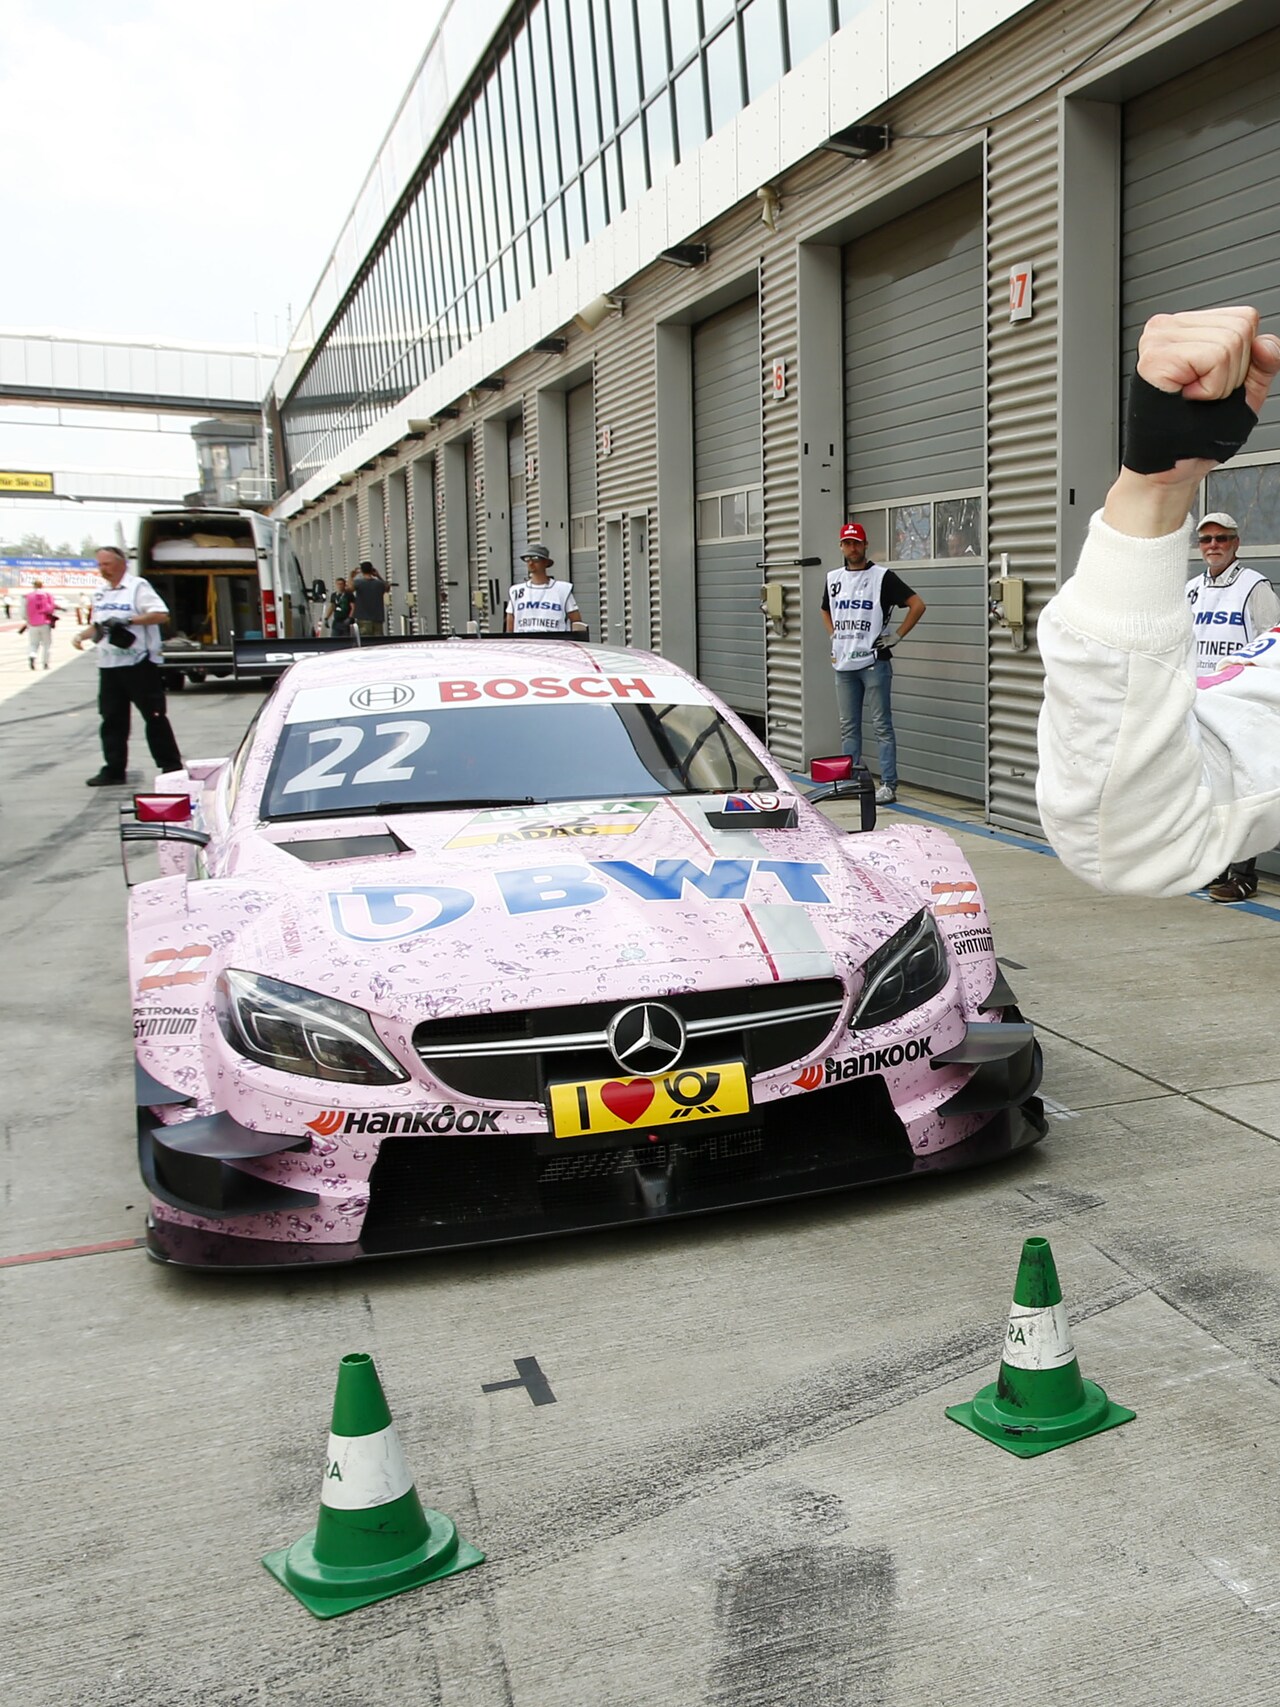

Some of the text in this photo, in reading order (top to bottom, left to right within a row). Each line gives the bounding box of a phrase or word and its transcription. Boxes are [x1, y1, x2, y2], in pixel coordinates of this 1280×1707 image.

[438, 676, 656, 703] BOSCH
[282, 719, 431, 795] 22
[491, 802, 643, 820] DEKRA
[496, 825, 600, 843] ADAC
[496, 858, 833, 916] BWT
[947, 927, 992, 941] PETRONAS
[132, 1006, 200, 1017] PETRONAS
